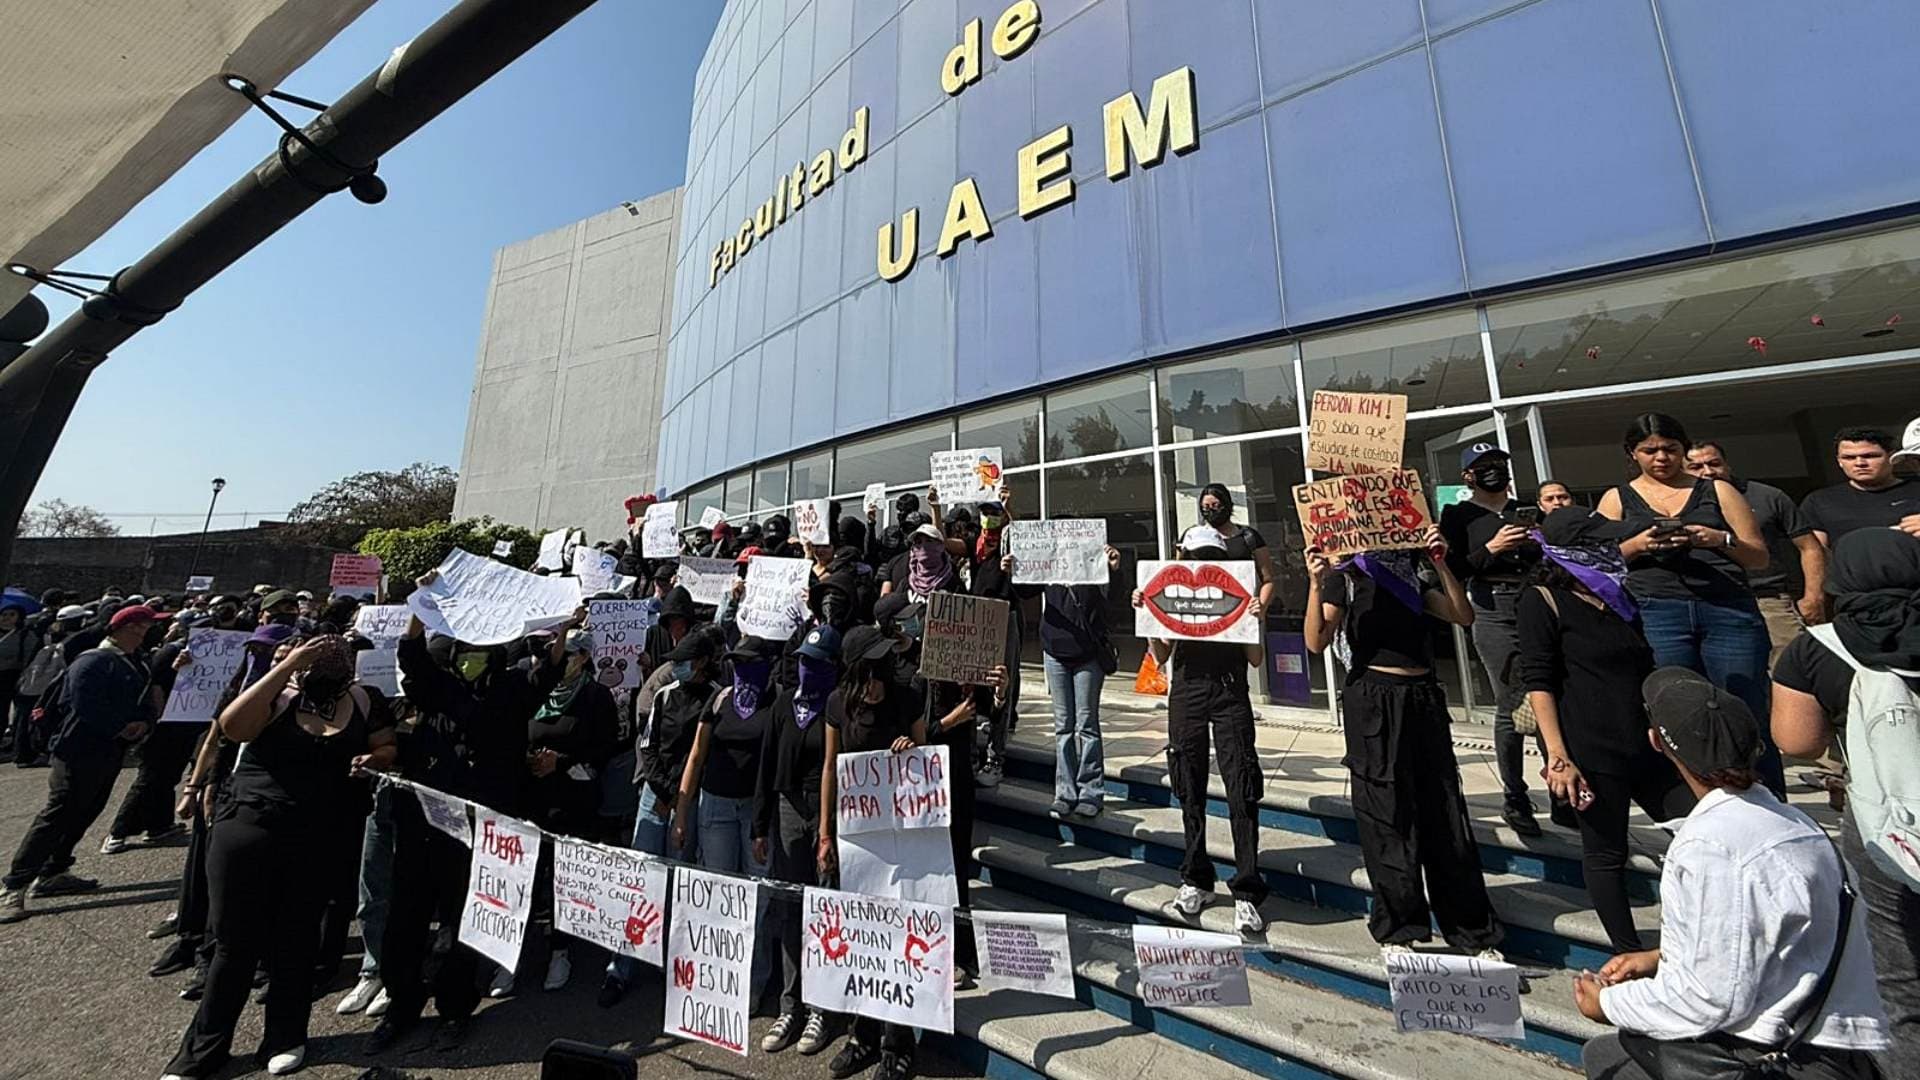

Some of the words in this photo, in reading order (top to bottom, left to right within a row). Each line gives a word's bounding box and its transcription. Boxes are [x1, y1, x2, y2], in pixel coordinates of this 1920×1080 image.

[709, 106, 870, 287] Facultad
[941, 0, 1042, 96] de
[877, 66, 1200, 282] UAEM
[1365, 425, 1386, 441] que
[1329, 457, 1345, 473] LA
[1391, 470, 1421, 492] QUE
[1310, 503, 1336, 519] TE
[1344, 493, 1406, 514] MOLESTA
[1309, 513, 1373, 536] VIRIDIANA
[1381, 513, 1401, 532] LA
[590, 602, 648, 616] QUEREMOS
[605, 631, 626, 644] NO
[841, 752, 944, 792] JUSTICIA
[840, 795, 881, 821] PARA
[481, 820, 525, 866] FUERA
[575, 844, 613, 867] PUESTO
[601, 869, 616, 882] DE
[516, 883, 526, 907] Y
[677, 869, 713, 911] HOY
[720, 884, 748, 922] SER
[558, 899, 596, 924] FUERA
[810, 893, 835, 916] LOS
[912, 908, 942, 934] NO
[688, 920, 745, 963] VENADO
[838, 926, 892, 951] CUIDAN
[673, 957, 695, 991] NO
[699, 963, 716, 991] ES
[720, 967, 739, 997] UN
[1388, 953, 1451, 977] SOMOS
[844, 973, 915, 1009] AMIGAS
[1144, 982, 1220, 1003] COMPLICE
[1450, 983, 1471, 996] DE
[1480, 985, 1511, 1001] LAS
[1427, 1000, 1455, 1014] QUE
[1464, 1002, 1486, 1014] NO
[682, 995, 744, 1047] ORGULLO
[1400, 1009, 1473, 1030] ESTAN
